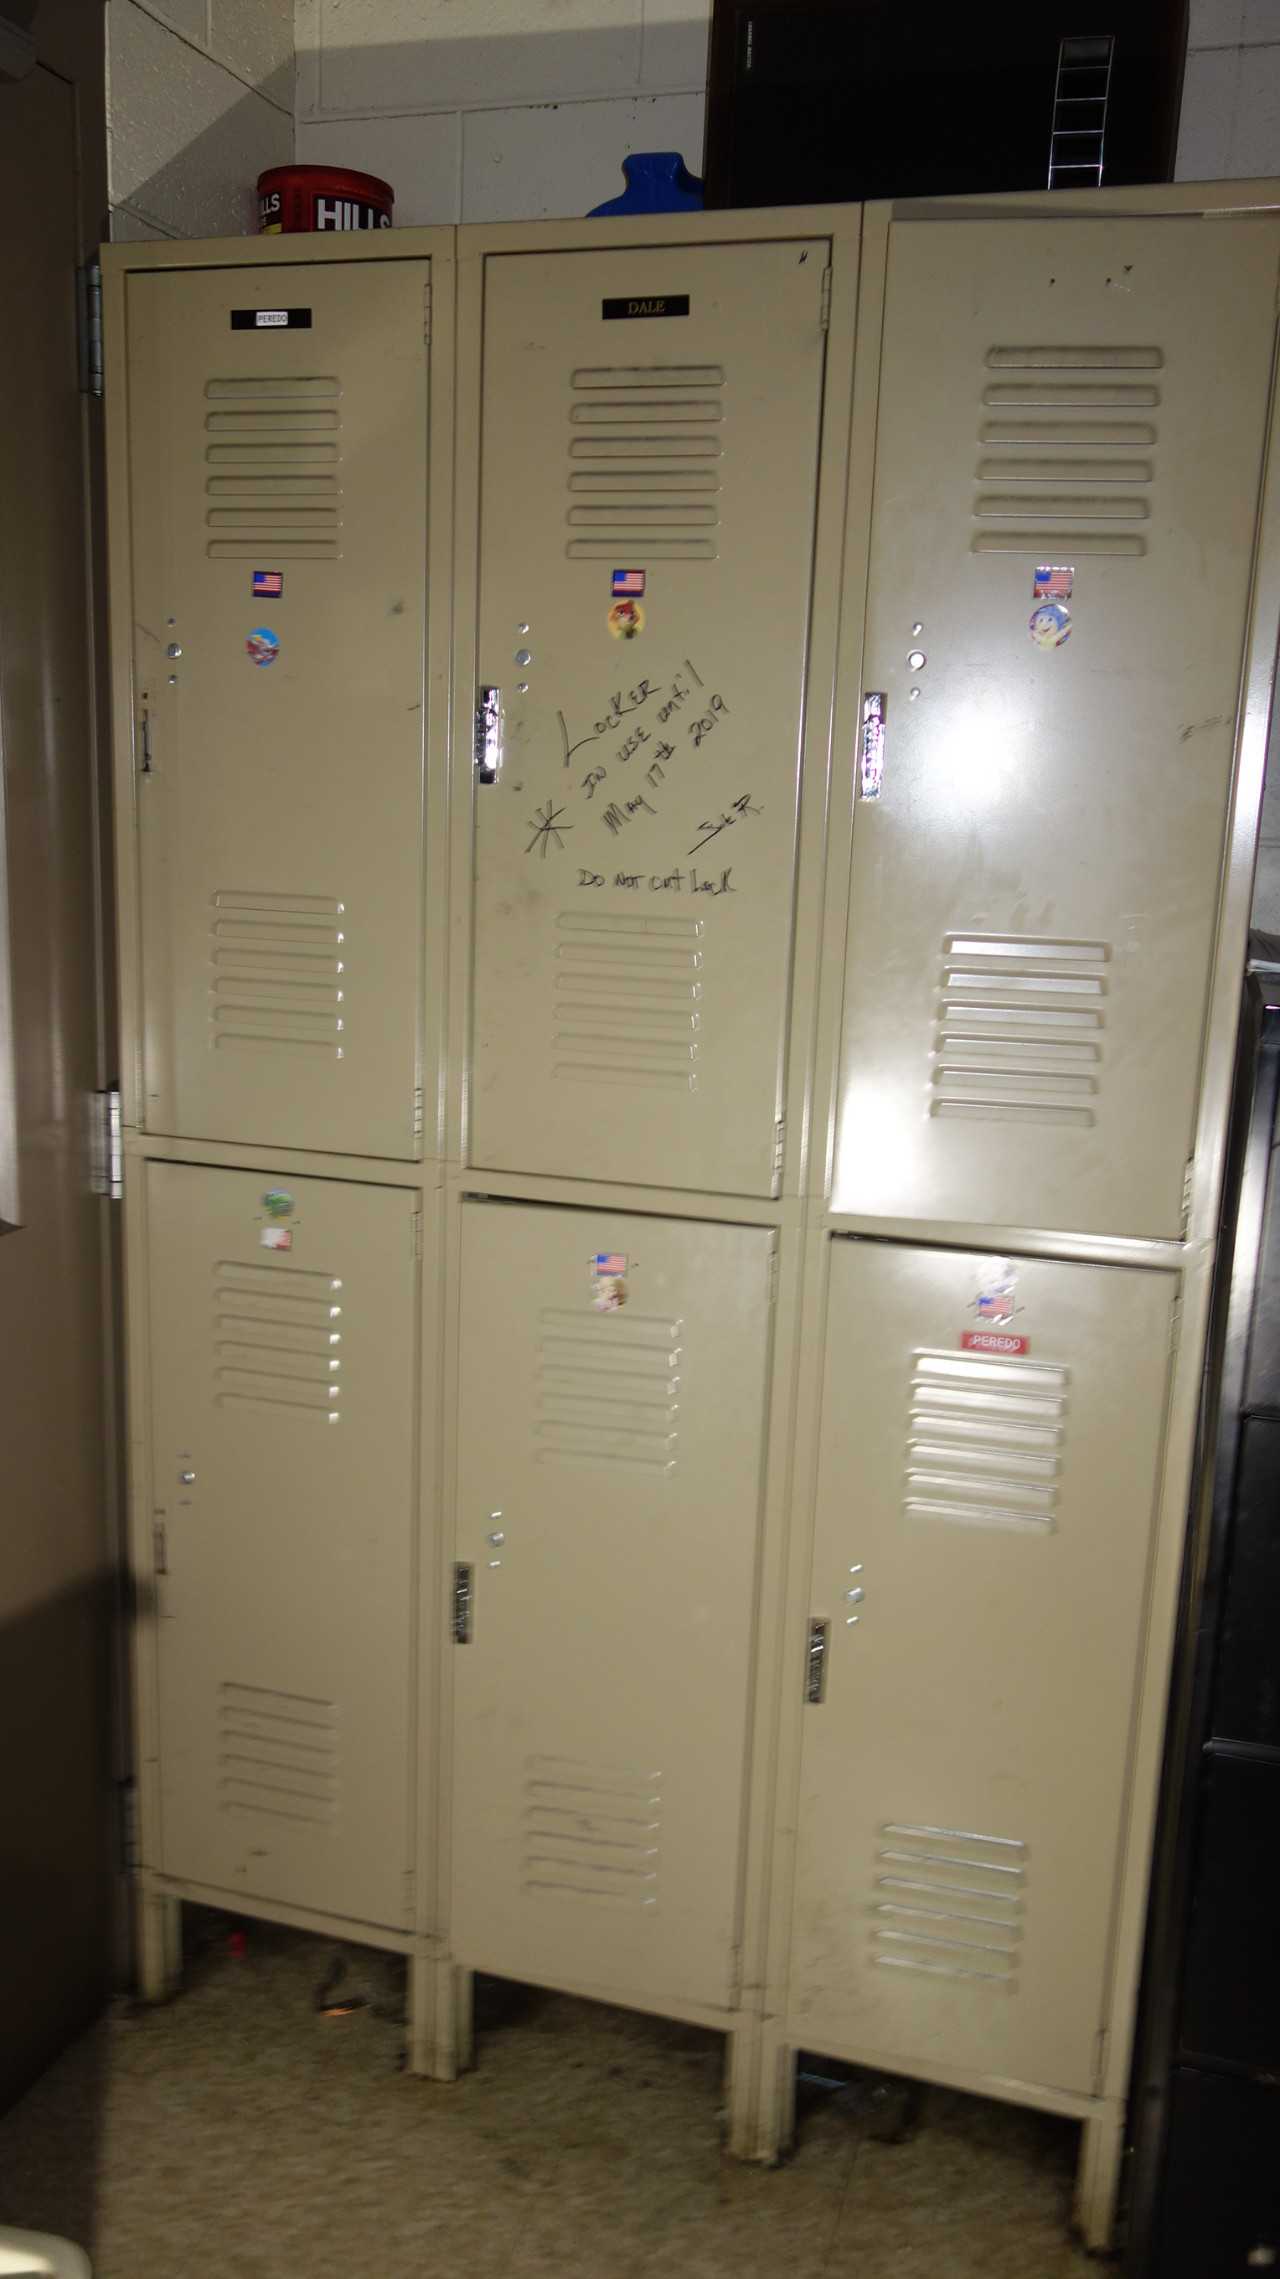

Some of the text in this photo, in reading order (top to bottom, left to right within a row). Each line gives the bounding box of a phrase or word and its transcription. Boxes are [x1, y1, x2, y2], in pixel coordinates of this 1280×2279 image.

[628, 300, 665, 315] DALE
[257, 313, 288, 323] PEREDO
[688, 693, 730, 747] 2019
[971, 1334, 1021, 1349] PEREDO
